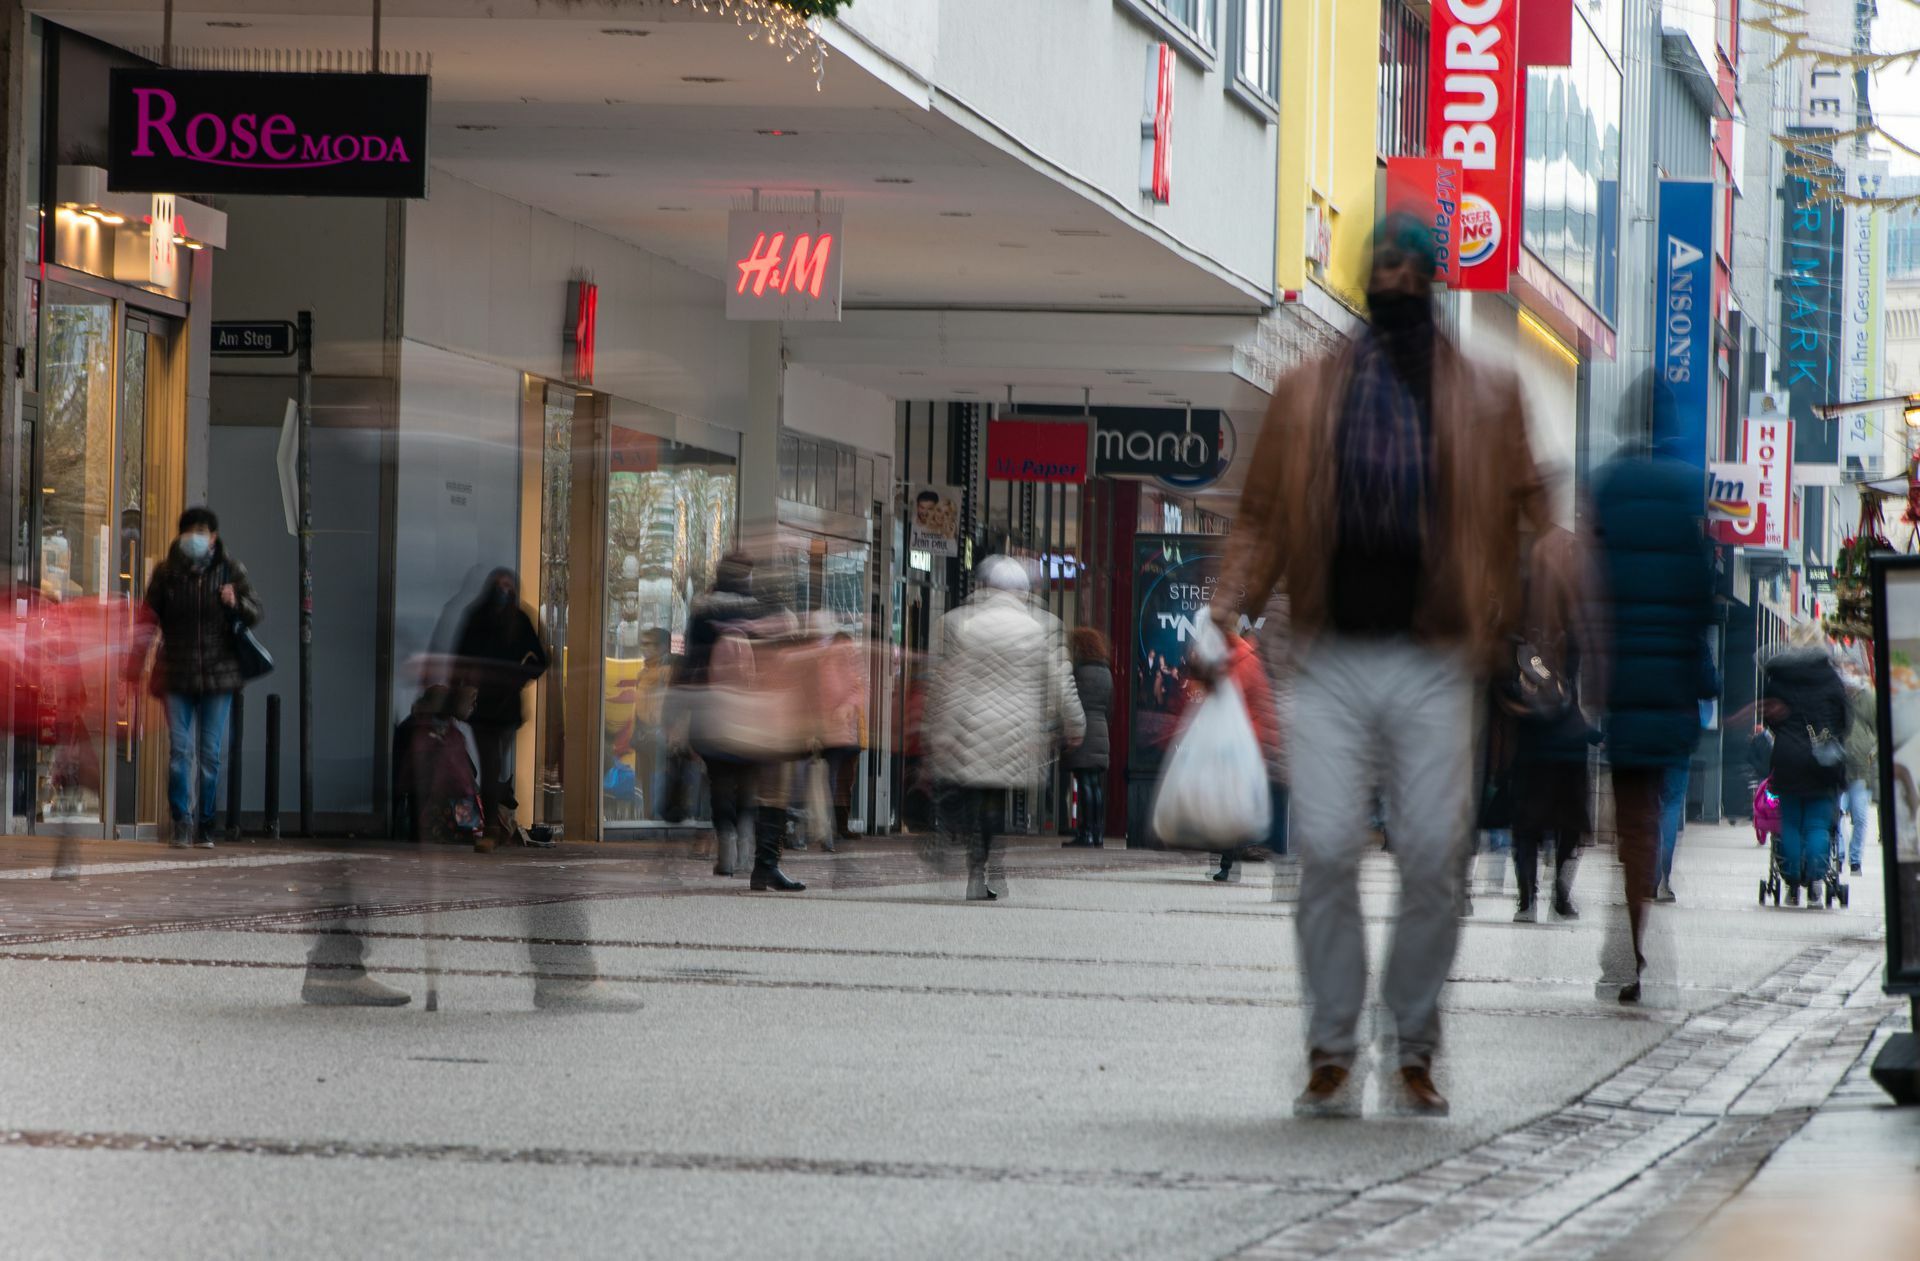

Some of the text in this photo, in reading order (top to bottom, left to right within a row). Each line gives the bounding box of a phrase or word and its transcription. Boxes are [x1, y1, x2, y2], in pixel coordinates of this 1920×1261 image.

[300, 134, 410, 162] MODA
[1463, 222, 1492, 242] NG
[737, 232, 832, 298] H&M
[1786, 176, 1818, 387] PRIMARK
[218, 330, 273, 349] Am Steg
[1851, 332, 1869, 368] Ihre
[1850, 417, 1867, 442] Zei
[1758, 426, 1776, 517] HOTE
